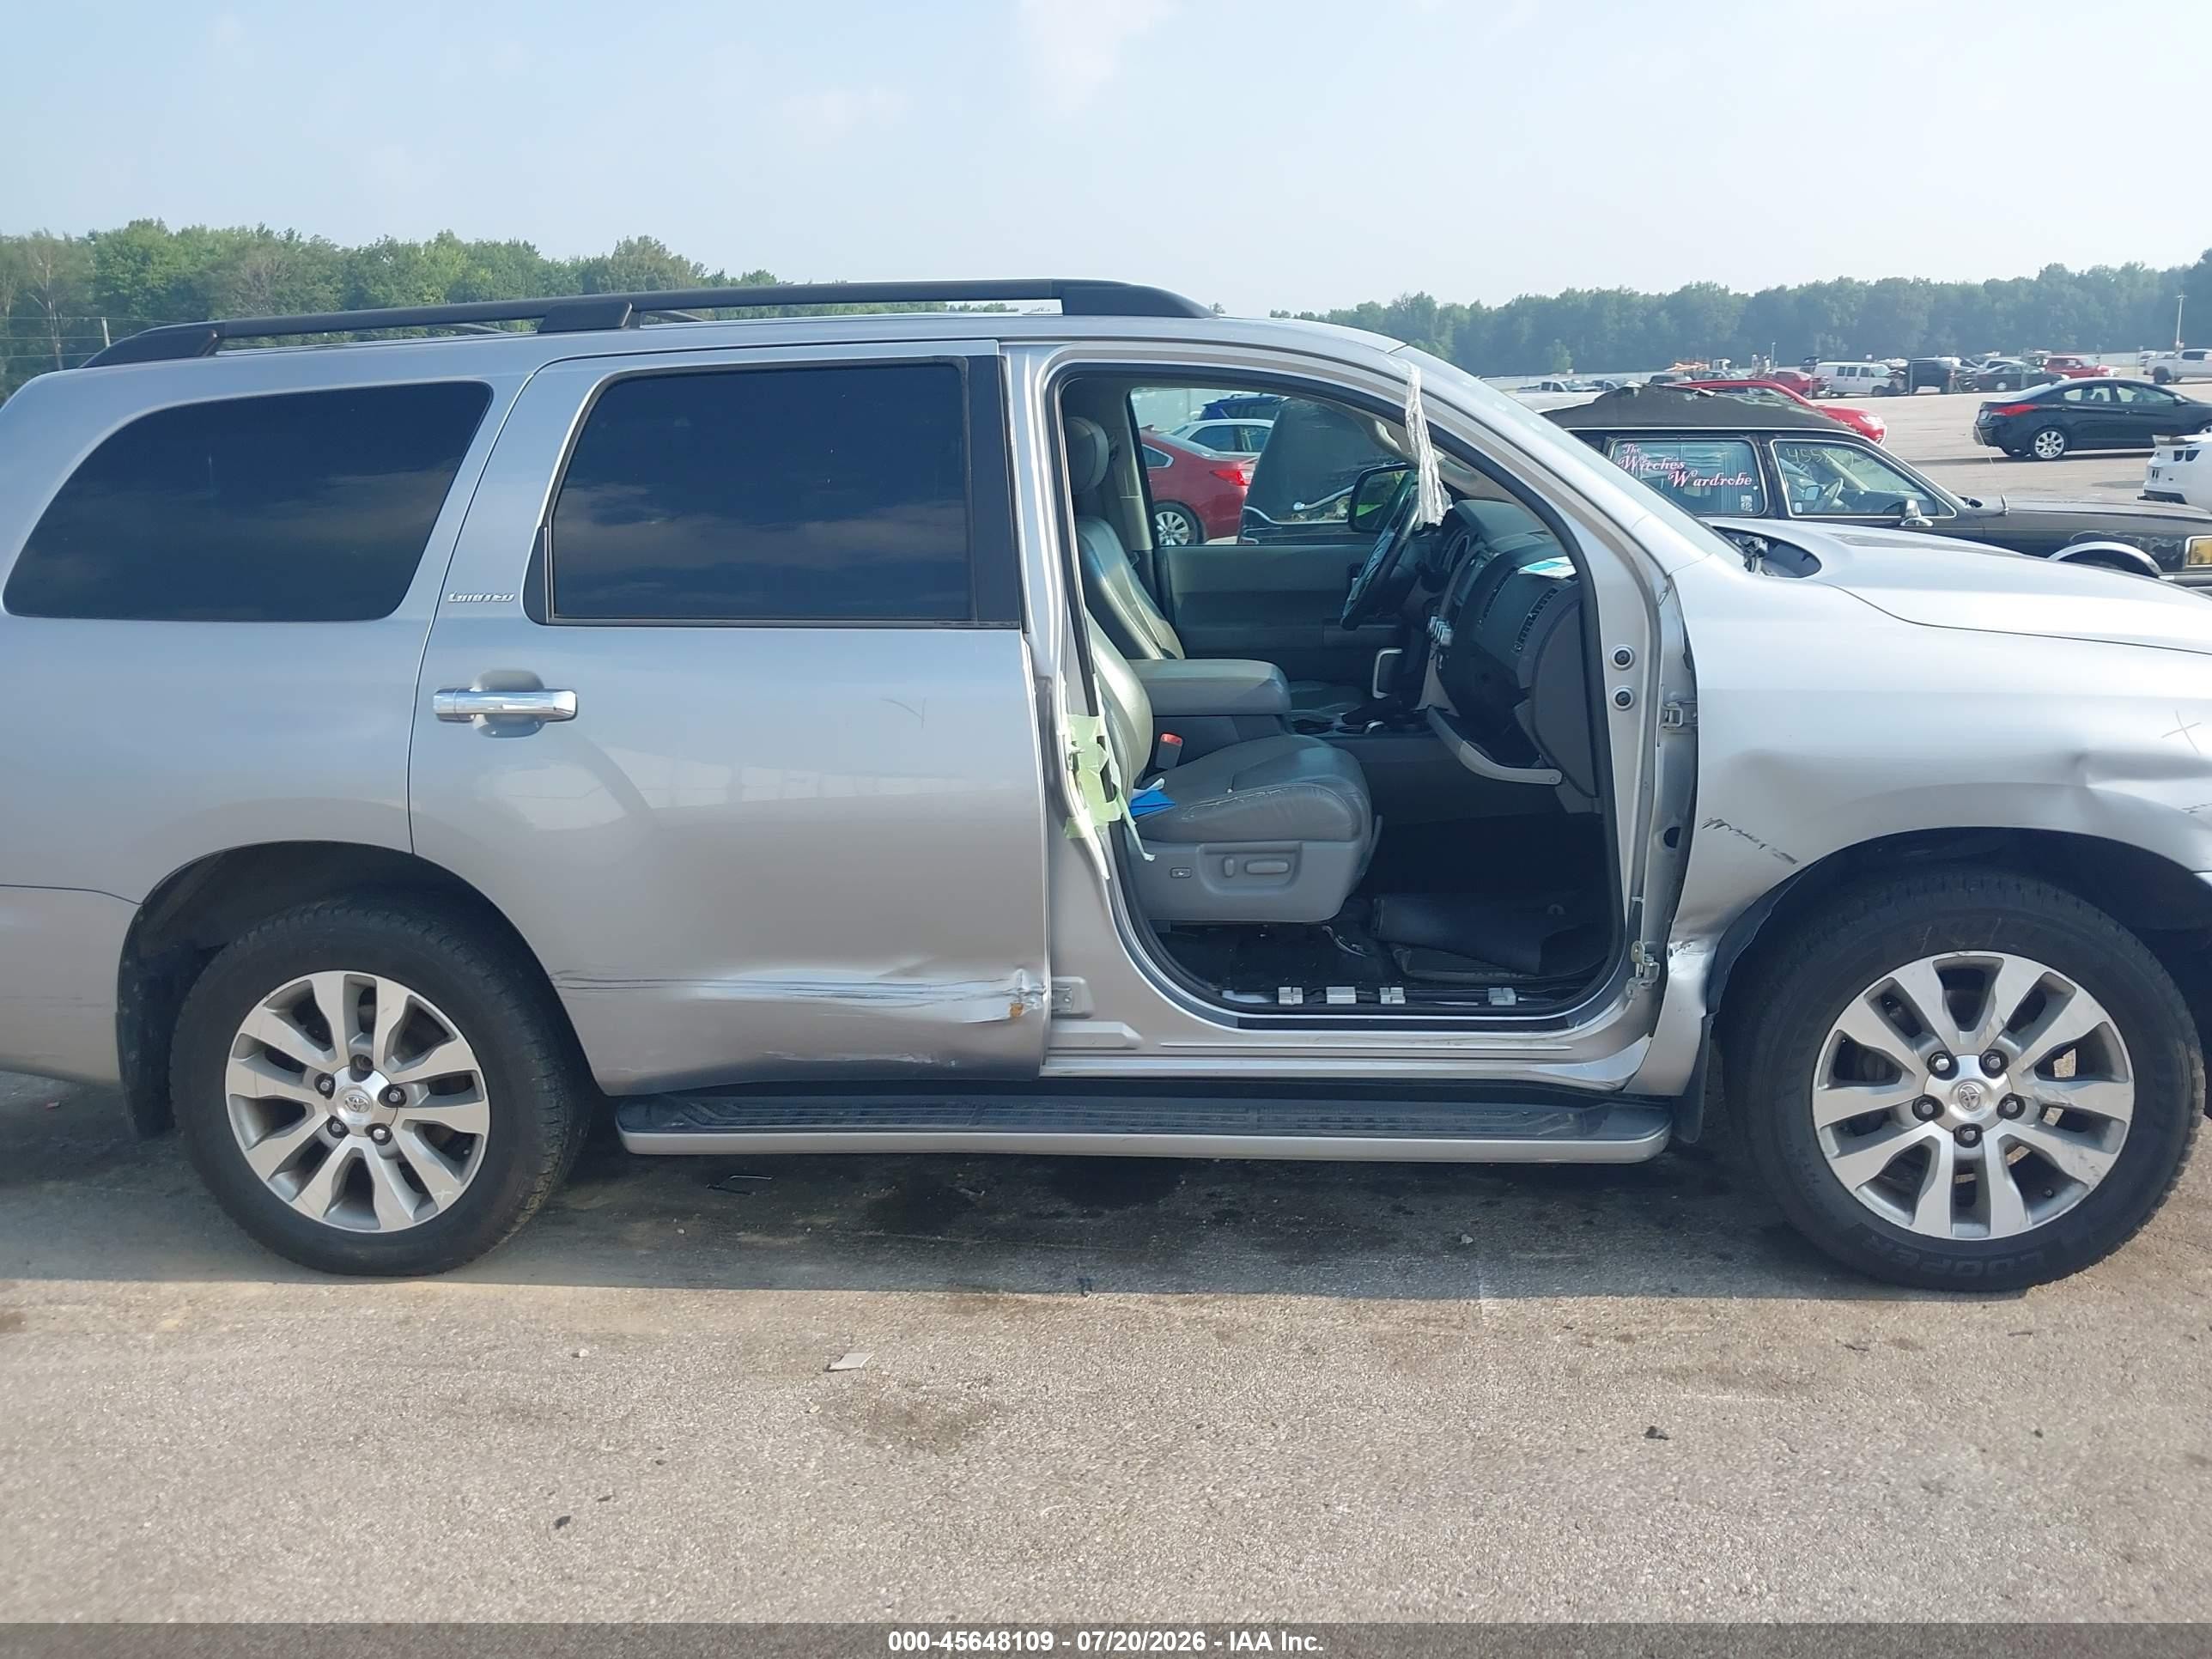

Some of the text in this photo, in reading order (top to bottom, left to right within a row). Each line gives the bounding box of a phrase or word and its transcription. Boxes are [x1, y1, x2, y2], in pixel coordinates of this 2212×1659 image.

[1621, 442, 1642, 455] The
[1617, 454, 1686, 471] Witches
[1668, 469, 1753, 488] Wardrobe
